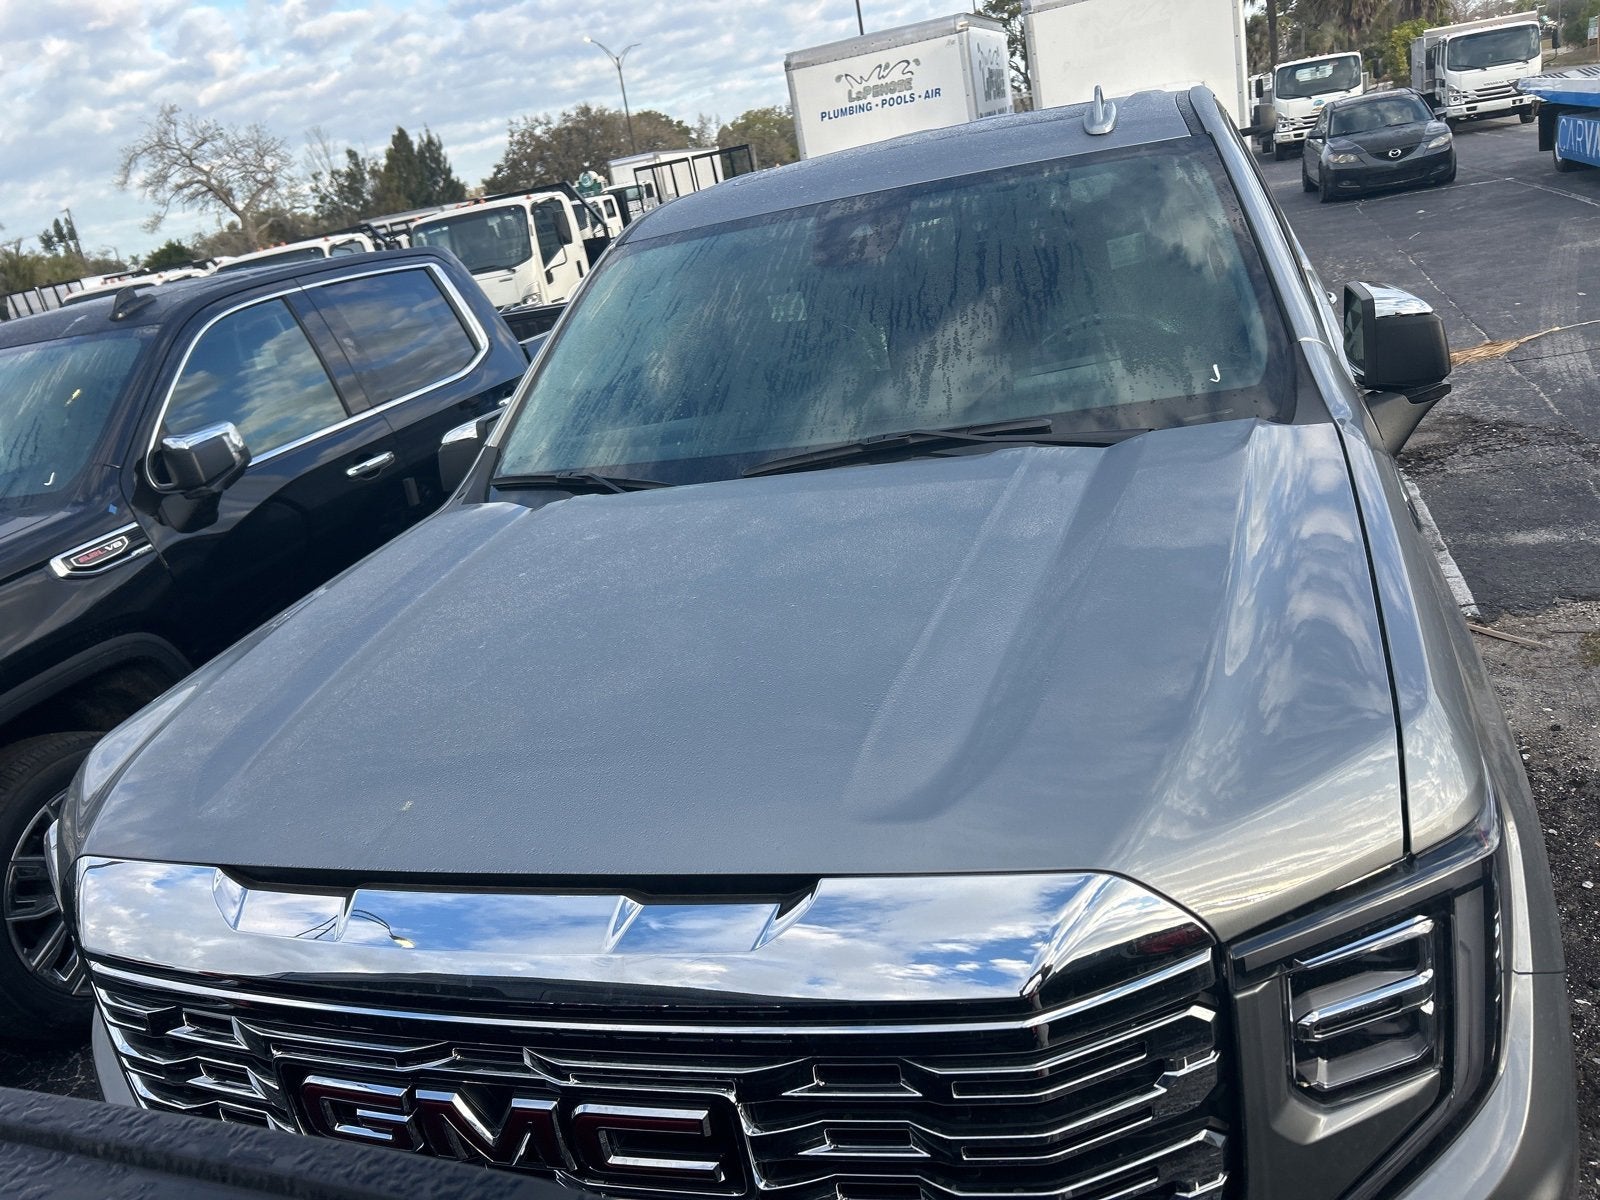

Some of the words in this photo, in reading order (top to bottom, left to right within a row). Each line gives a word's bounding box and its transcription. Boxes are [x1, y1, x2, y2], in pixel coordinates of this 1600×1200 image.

[820, 101, 873, 121] PLUMBING
[881, 92, 916, 108] POOLS
[924, 87, 942, 99] AIR
[301, 1074, 726, 1183] GMC
